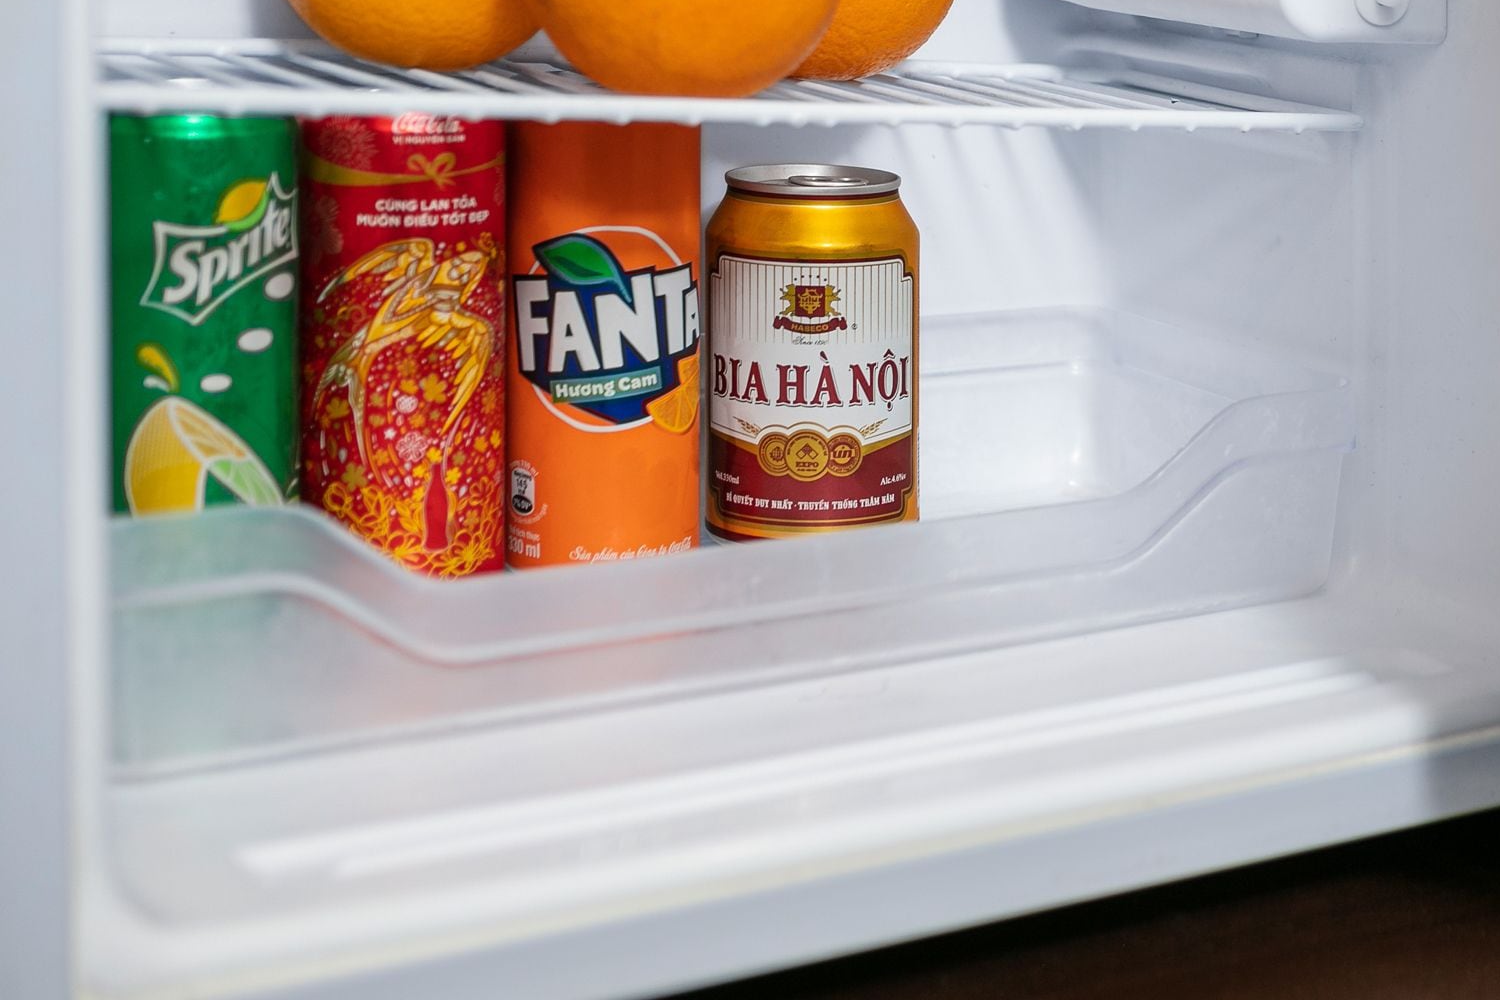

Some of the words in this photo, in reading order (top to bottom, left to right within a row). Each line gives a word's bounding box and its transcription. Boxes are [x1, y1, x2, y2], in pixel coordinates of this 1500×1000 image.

[420, 198, 450, 212] LAN
[162, 198, 290, 306] Sprite
[515, 267, 699, 373] FANTA
[791, 323, 829, 332] HABECO
[555, 379, 615, 398] Hương
[618, 373, 658, 391] Cam
[714, 353, 769, 406] BIA
[775, 351, 844, 408] HÀ
[848, 348, 909, 411] NỘI
[733, 494, 754, 506] QUYẾT
[755, 498, 769, 508] DUY
[771, 499, 793, 510] NHẤT
[832, 498, 858, 509] THỐNG
[508, 535, 524, 555] 330
[525, 543, 541, 559] ml
